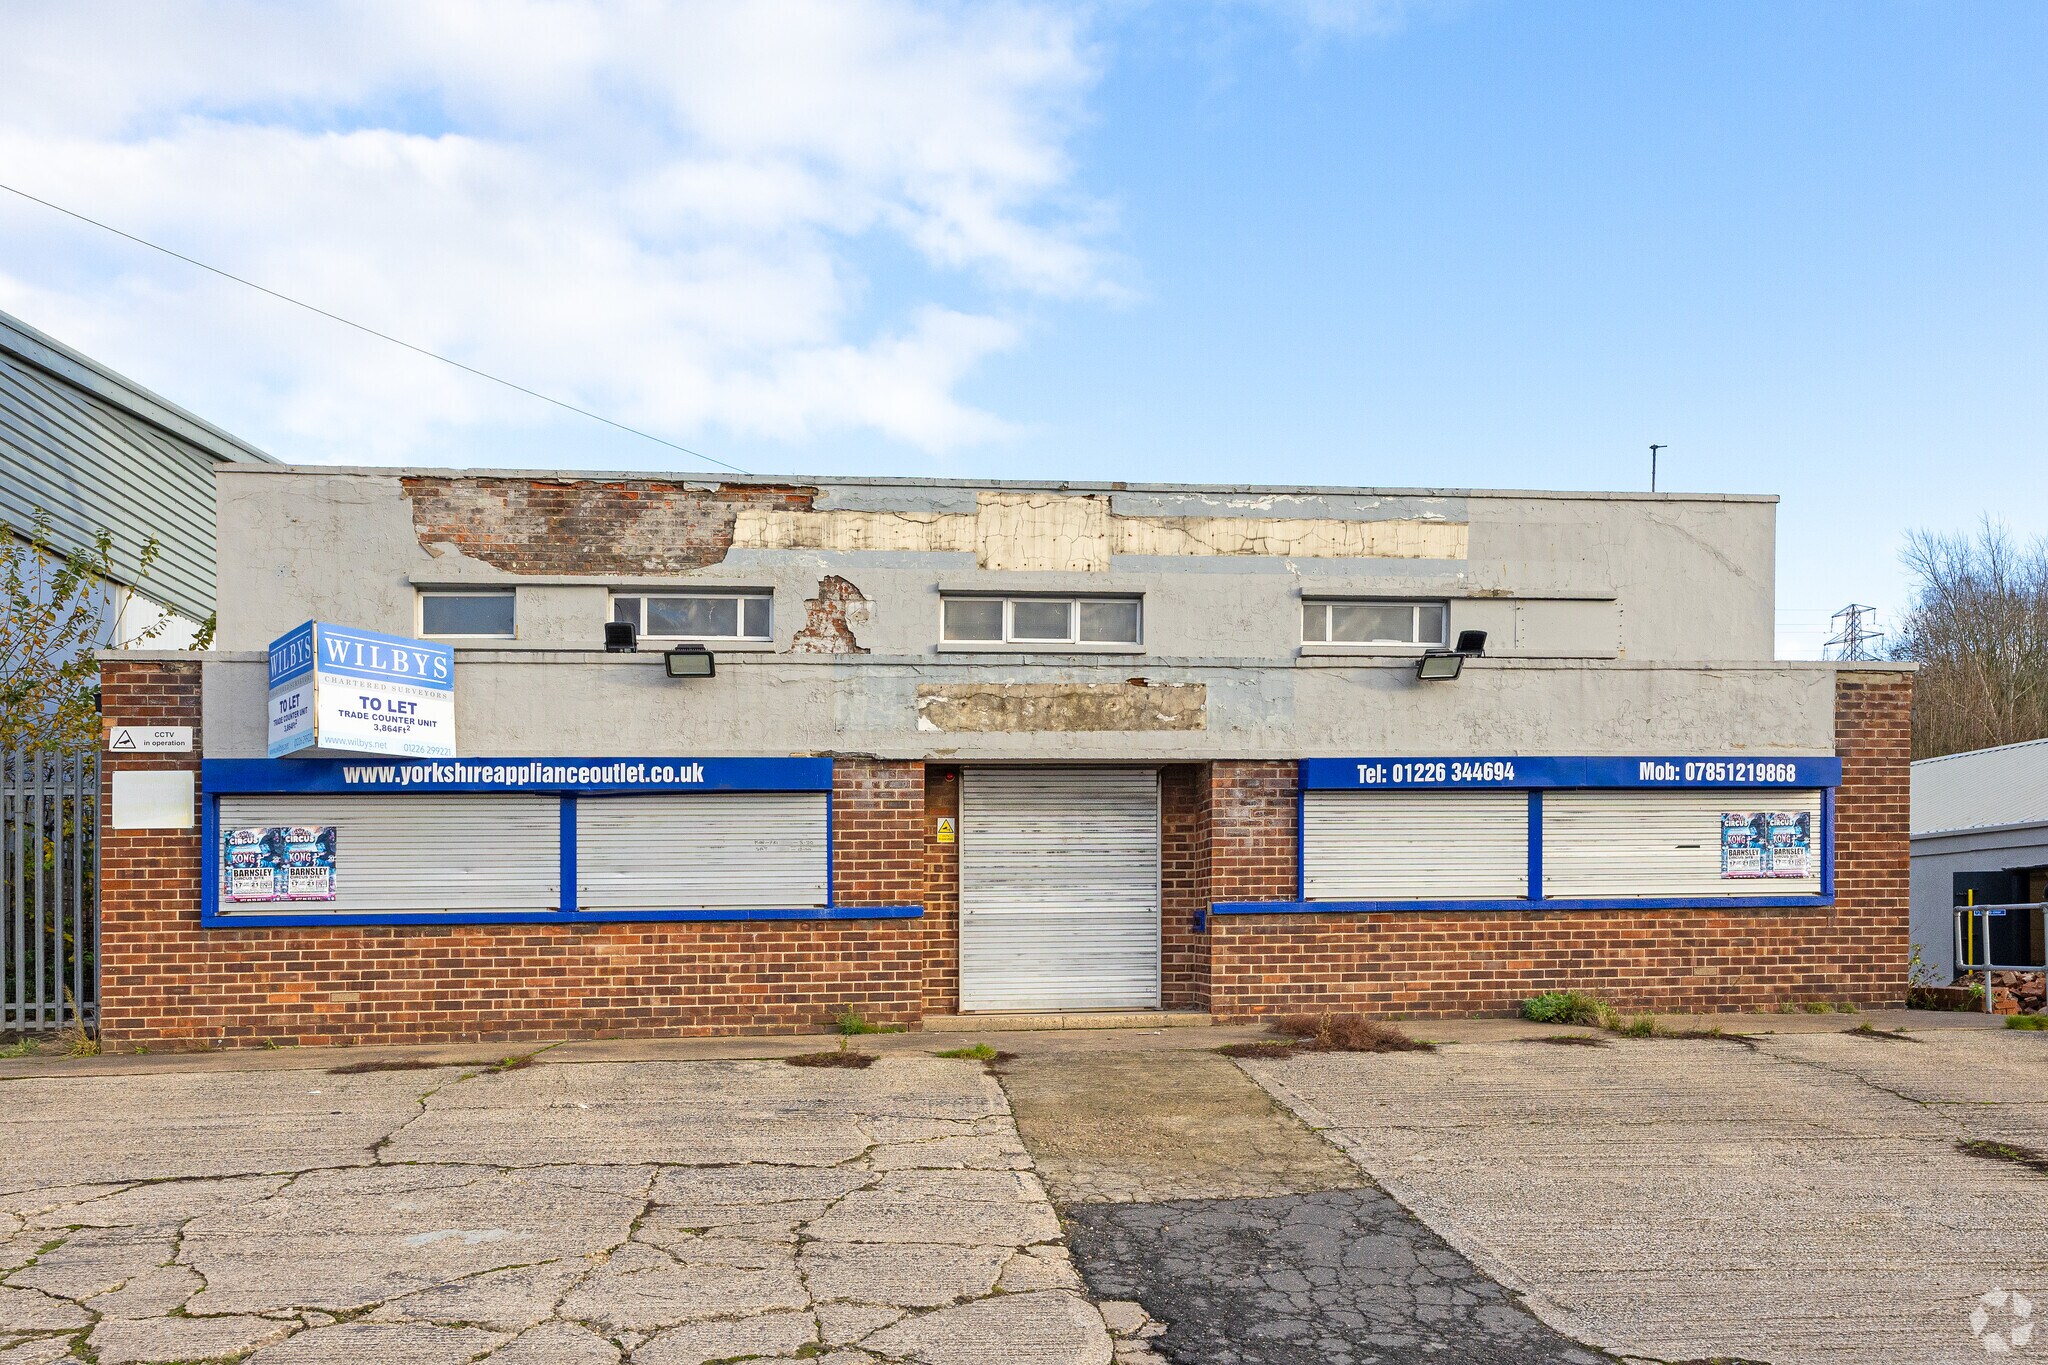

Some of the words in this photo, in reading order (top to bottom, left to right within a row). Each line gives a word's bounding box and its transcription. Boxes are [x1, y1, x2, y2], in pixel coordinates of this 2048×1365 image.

[270, 635, 311, 677] WILBYS
[324, 637, 448, 679] WILBYS
[324, 675, 387, 690] CHARTERED
[391, 685, 448, 699] SURVEYORS
[279, 699, 288, 713] TO
[288, 693, 300, 710] LET
[359, 695, 382, 711] TO
[387, 699, 418, 715] LET
[338, 709, 369, 720] TRADE
[371, 713, 416, 725] COUNTER
[417, 719, 438, 728] UNIT
[324, 736, 388, 750] www.wilbys.net
[403, 743, 425, 754] 01226
[426, 746, 452, 757] 299221
[343, 762, 704, 785] www.yorkshireapplianceoutlet.co.uk
[1357, 764, 1387, 784] Tel:
[1392, 763, 1446, 783] 01226
[1451, 761, 1515, 782] 344694
[1639, 761, 1680, 781] Mob:
[1685, 762, 1796, 783] 07851219868
[230, 837, 258, 845] CIRCUS
[285, 835, 315, 843] CIRCUS
[1728, 835, 1746, 844] KONG
[1773, 834, 1790, 843] KONG
[232, 854, 255, 863] KONG
[290, 852, 311, 862] KONG
[233, 869, 272, 877] BARNSLEY
[290, 868, 327, 876] BARNSLEY
